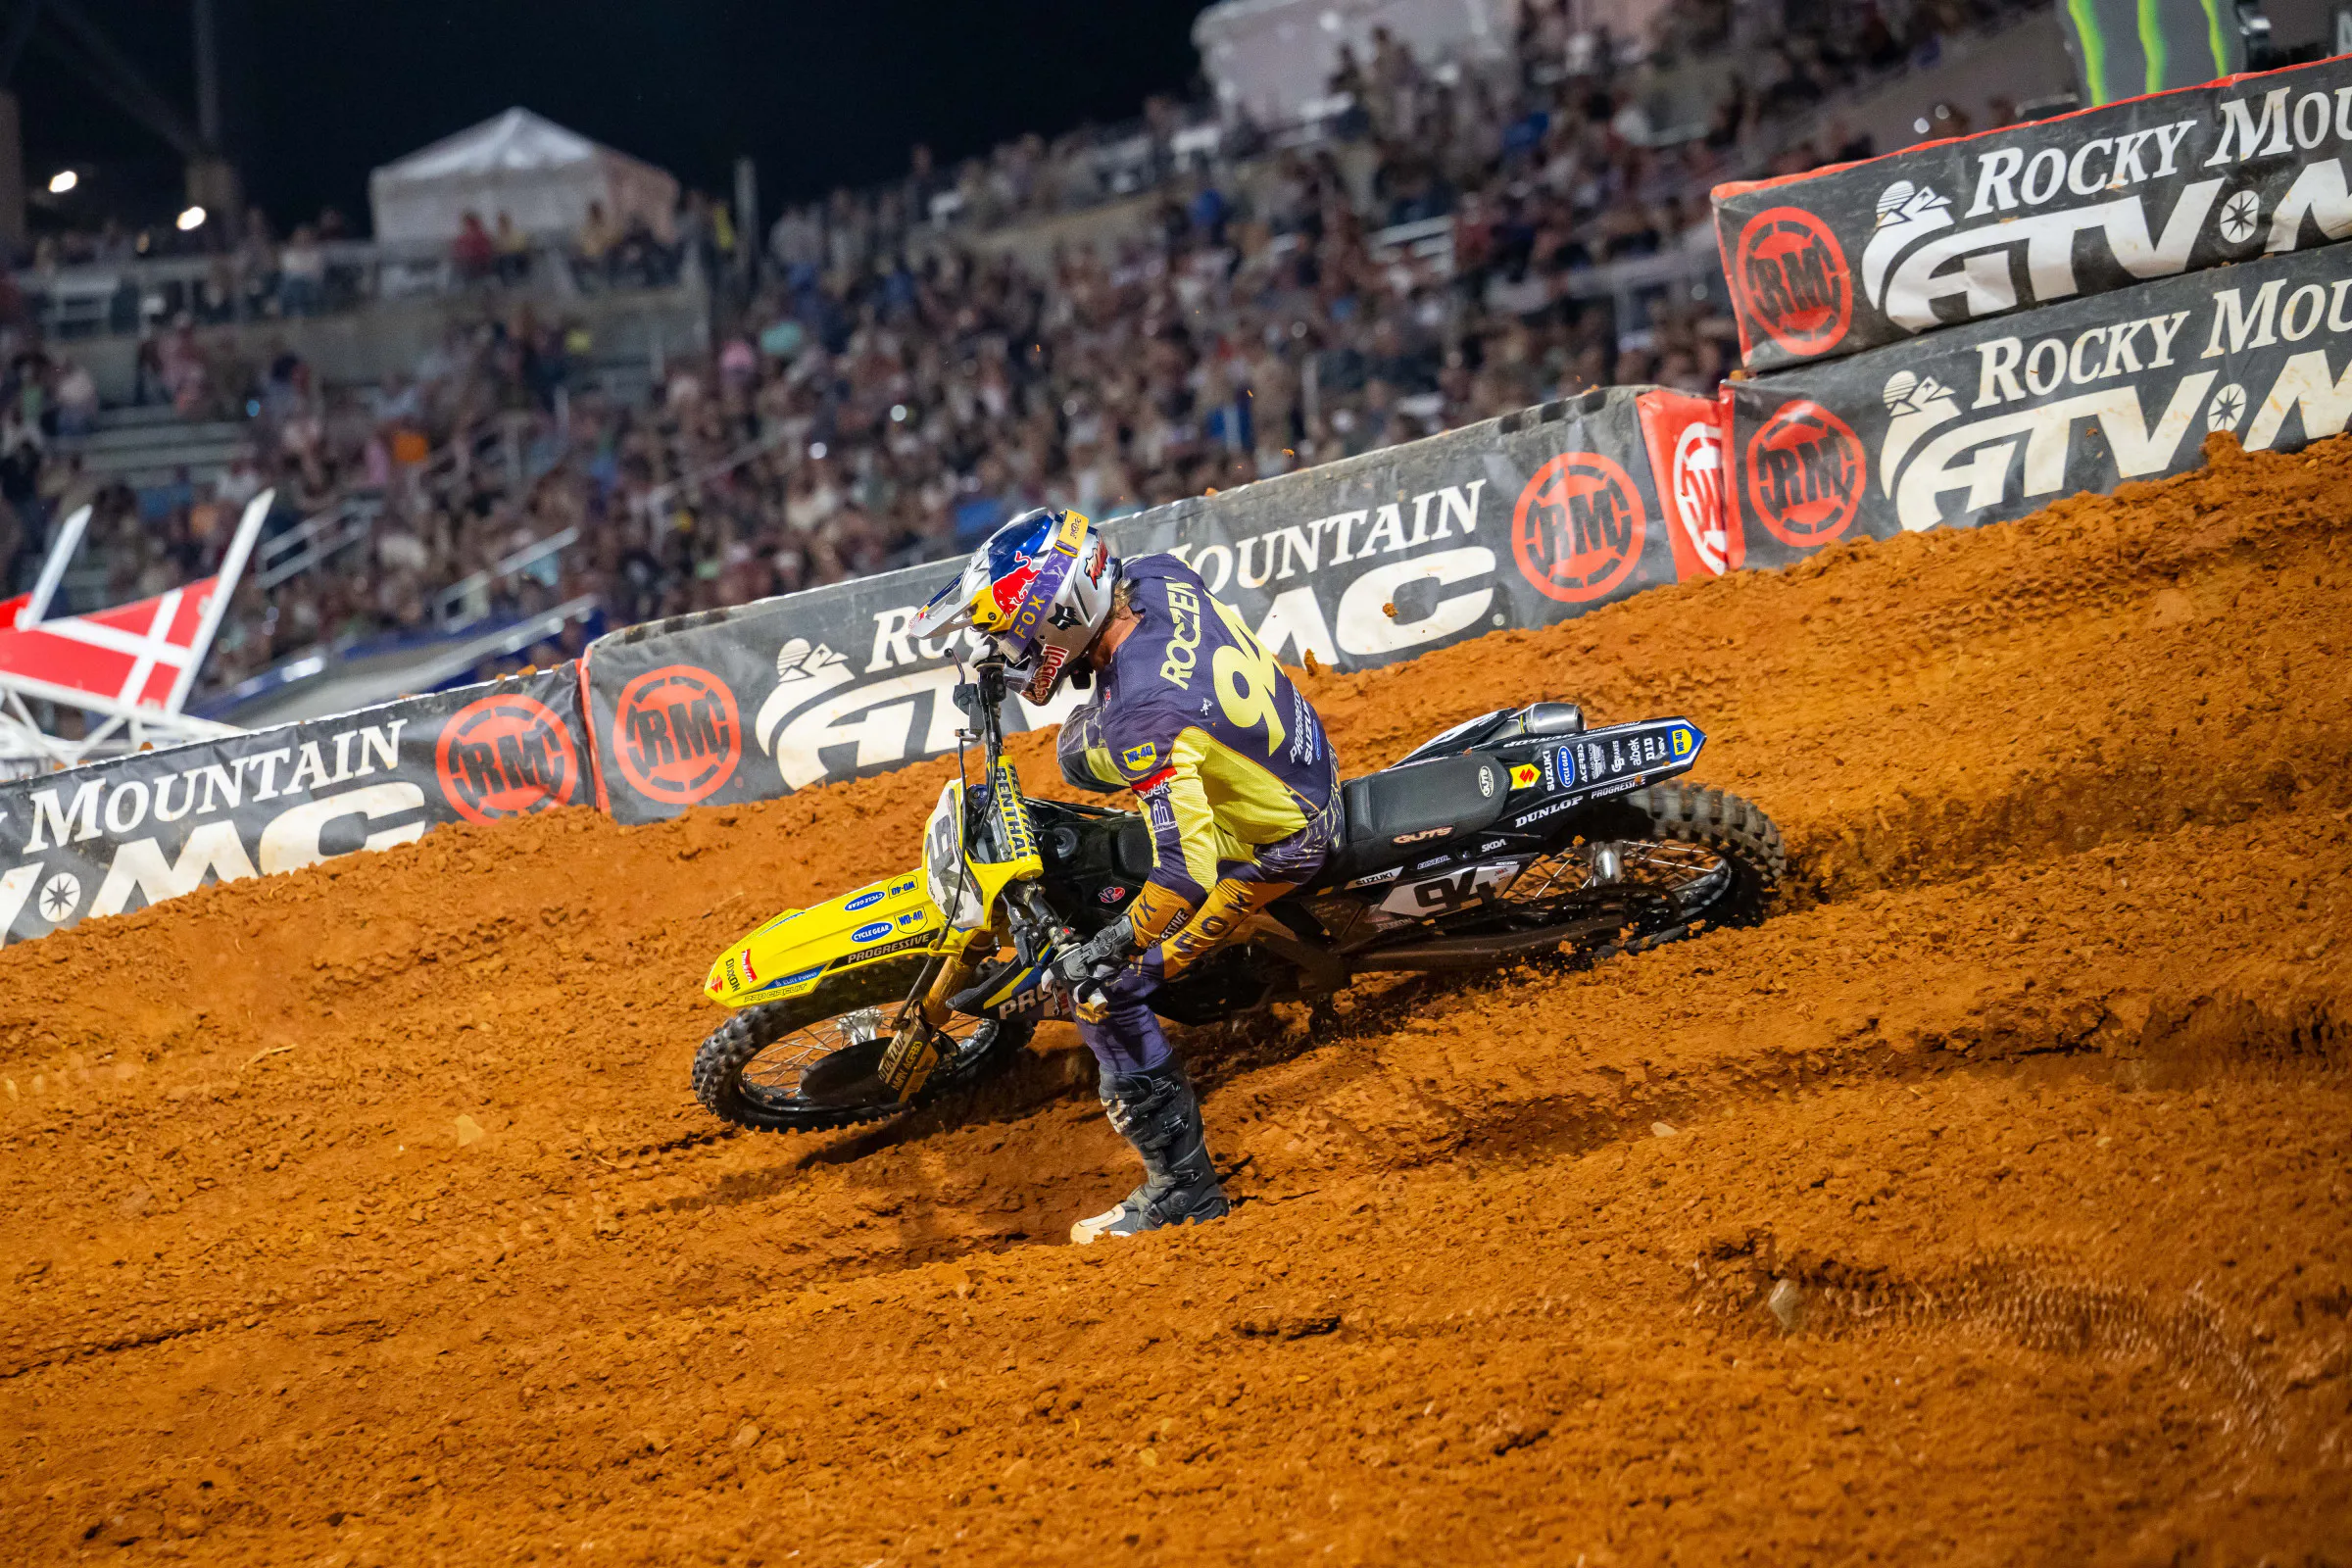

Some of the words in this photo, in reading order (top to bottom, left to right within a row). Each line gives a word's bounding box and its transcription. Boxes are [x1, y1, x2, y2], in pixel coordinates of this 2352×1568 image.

[1963, 121, 2197, 218] ROCKY
[1972, 310, 2189, 410] ROCKY
[1169, 479, 1487, 591] OUNTAIN
[1014, 594, 1046, 639] FOX
[23, 718, 409, 855] MOUNTAIN
[1542, 750, 1555, 792] SUZUKI
[1591, 776, 1647, 800] PROGRESSIE
[1515, 796, 1584, 828] DUNLOP
[1393, 826, 1453, 844] GUTS
[1355, 871, 1394, 886] SUZUKI
[1413, 865, 1498, 918] 94
[854, 929, 873, 941] CYCLE
[872, 924, 890, 935] GEAR
[899, 909, 924, 926] WD-40
[848, 933, 930, 964] PROGRESSIVE
